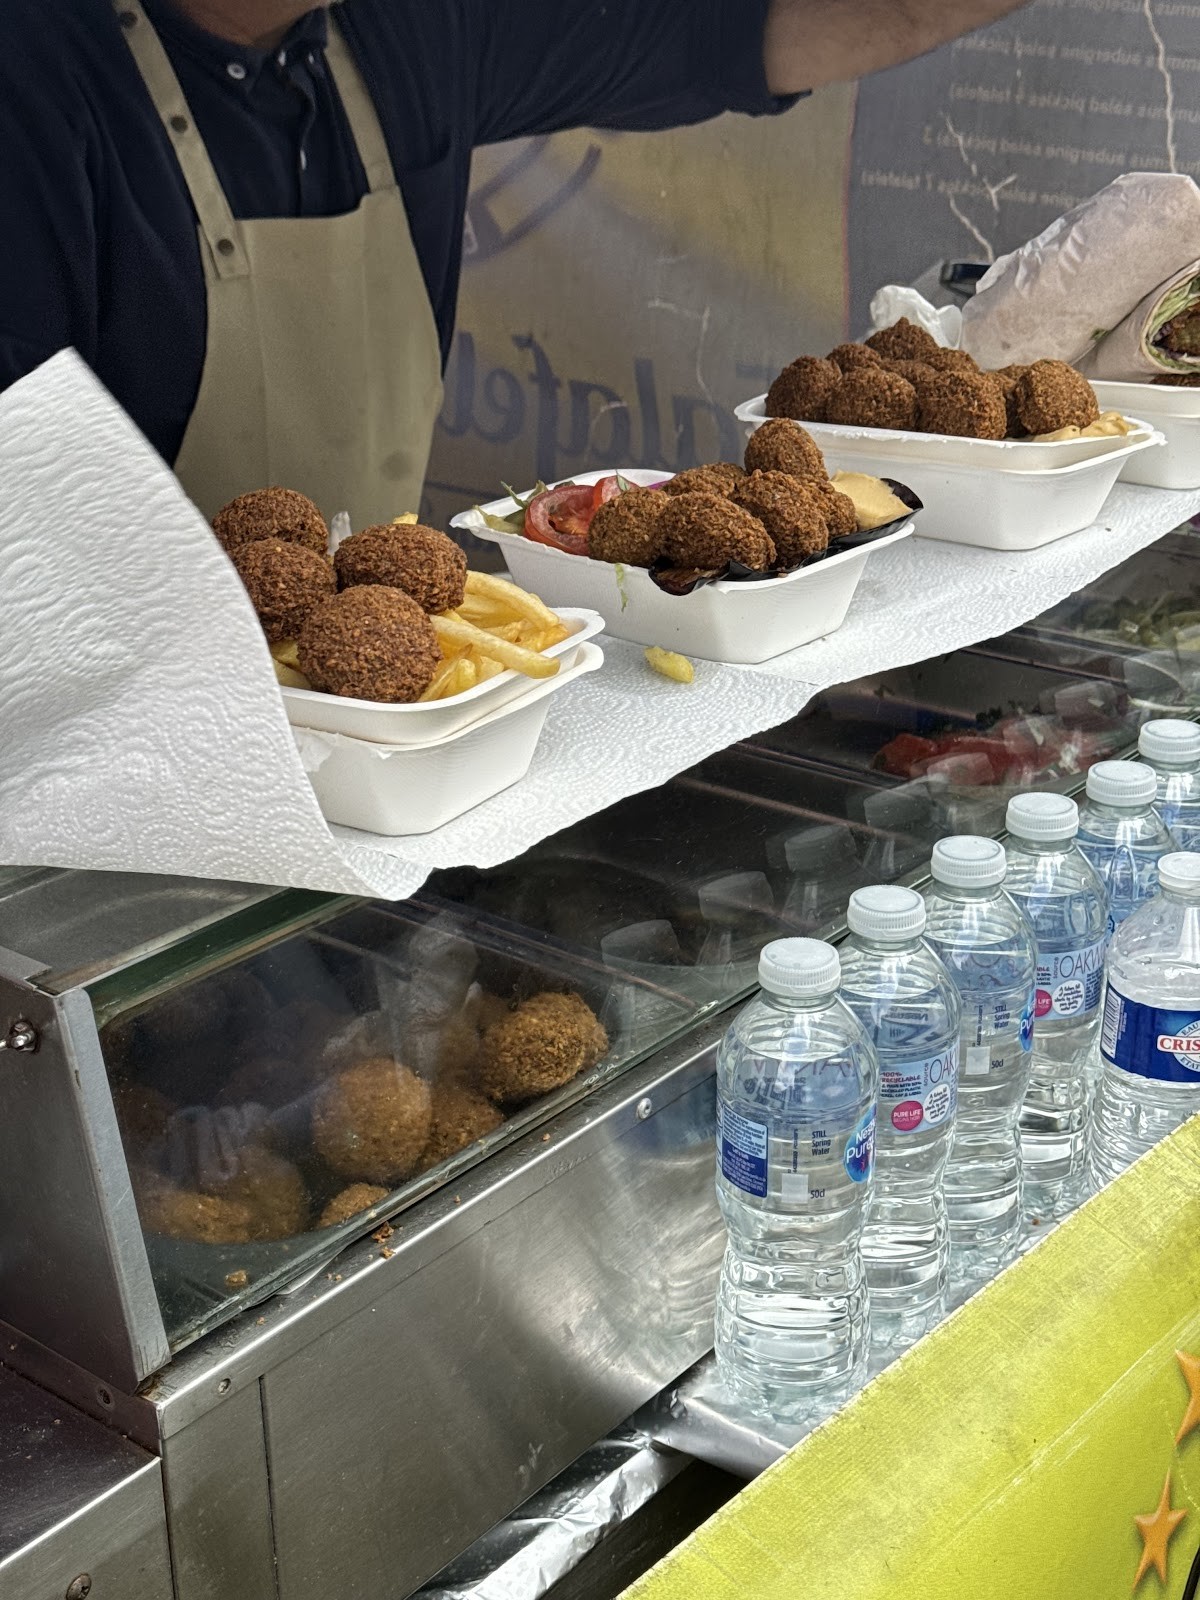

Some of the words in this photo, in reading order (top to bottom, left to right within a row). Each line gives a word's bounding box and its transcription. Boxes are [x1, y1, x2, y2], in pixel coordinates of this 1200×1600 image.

[994, 1004, 1008, 1012] STILL
[994, 1012, 1010, 1021] Spring
[994, 1021, 1010, 1029] Water
[1181, 1022, 1199, 1036] EAU
[1159, 1037, 1200, 1051] CRIS
[991, 1059, 1004, 1069] 50cl
[893, 1110, 909, 1118] PURE
[909, 1108, 922, 1116] LIFE
[812, 1129, 827, 1139] STILL
[812, 1138, 832, 1148] Spring
[812, 1147, 830, 1156] Water
[810, 1189, 826, 1199] 50cl
